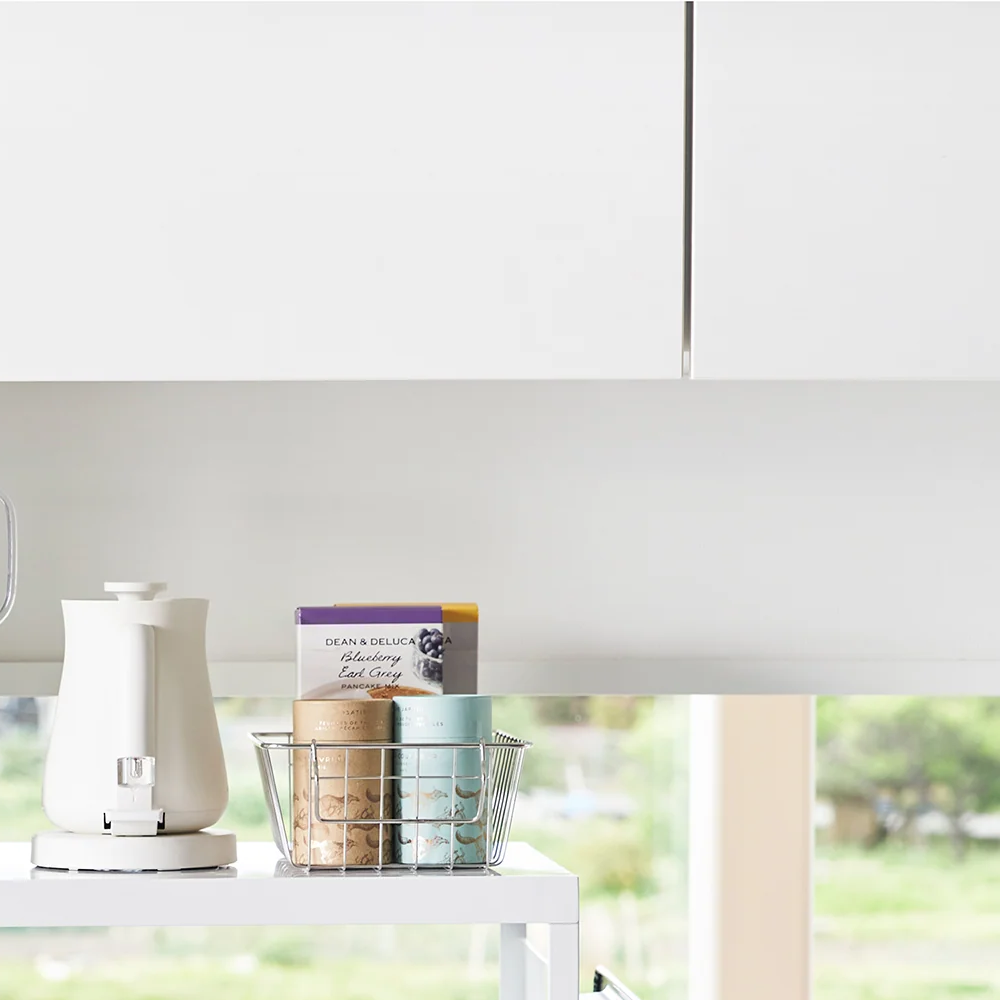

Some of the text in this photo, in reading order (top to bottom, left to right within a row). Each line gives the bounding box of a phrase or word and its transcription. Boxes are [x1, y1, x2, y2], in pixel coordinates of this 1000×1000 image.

[325, 637, 416, 646] DEAN & DELUCA
[340, 650, 402, 667] Blueberry
[338, 665, 403, 684] Earl Grey
